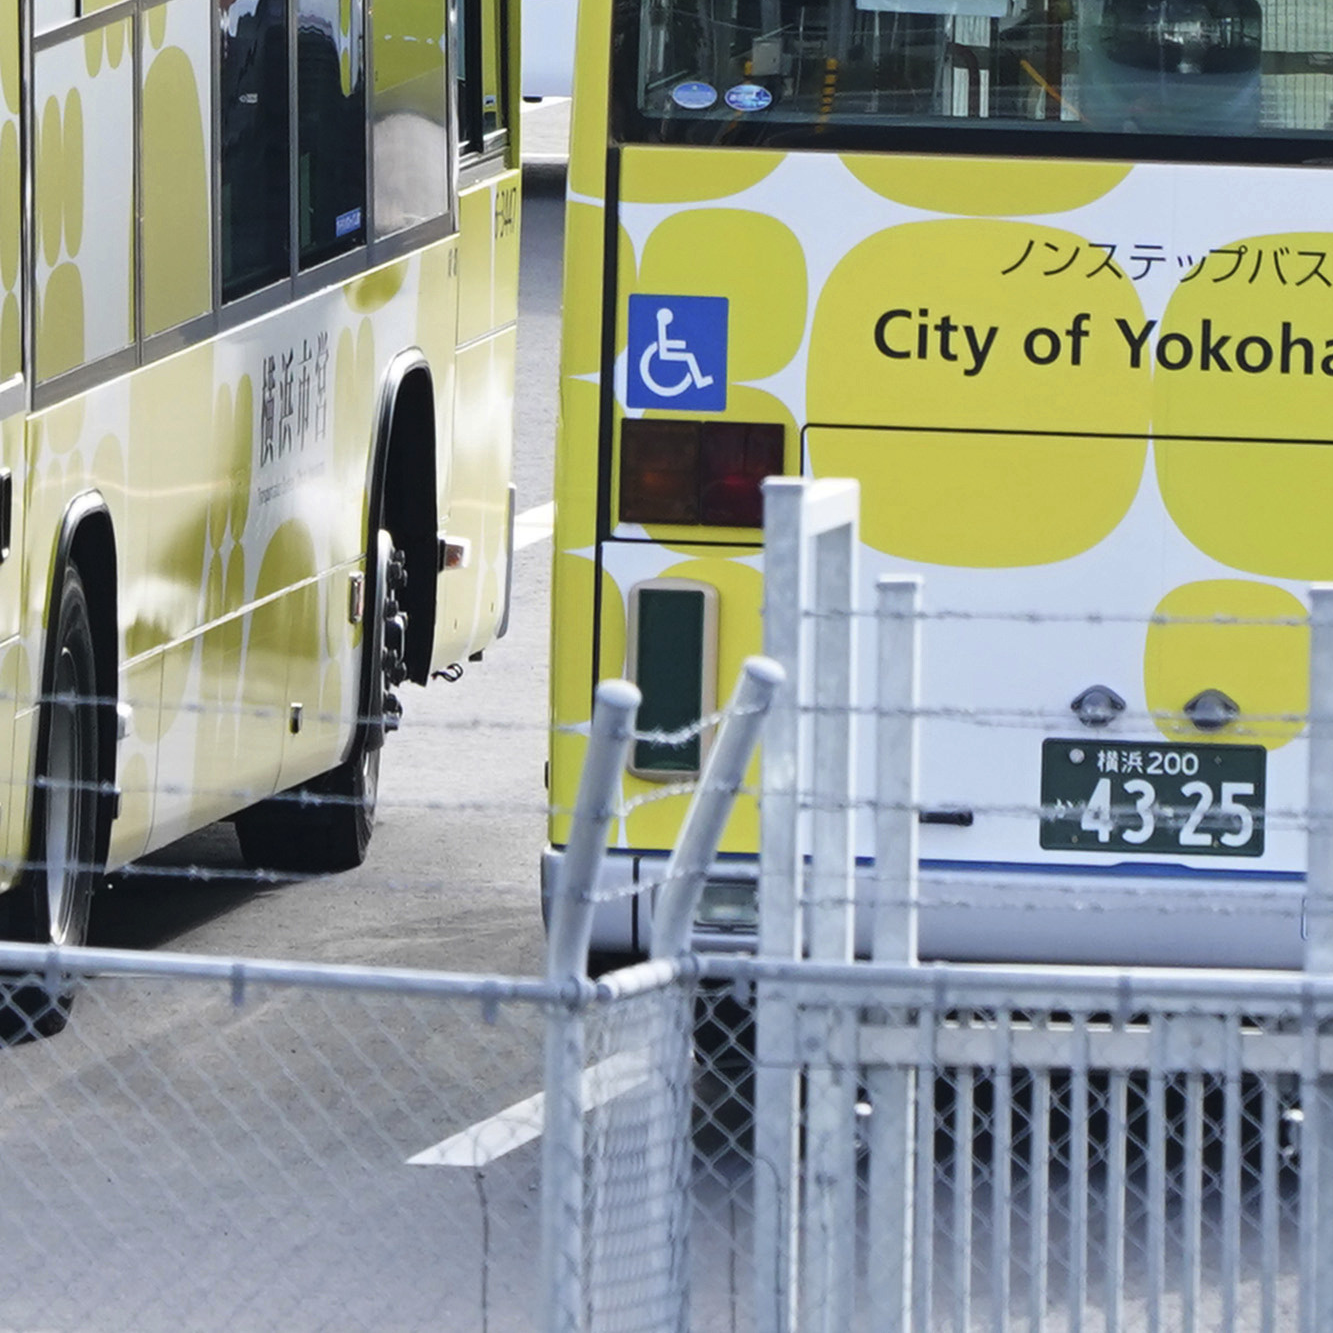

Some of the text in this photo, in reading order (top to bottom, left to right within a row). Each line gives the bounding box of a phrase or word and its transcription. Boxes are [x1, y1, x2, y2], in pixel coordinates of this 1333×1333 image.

[999, 238, 1333, 289] ノンステップバス
[873, 307, 998, 377] City
[1022, 312, 1091, 366] of
[259, 331, 329, 468] 横浜市営
[1096, 749, 1200, 776] 横浜200
